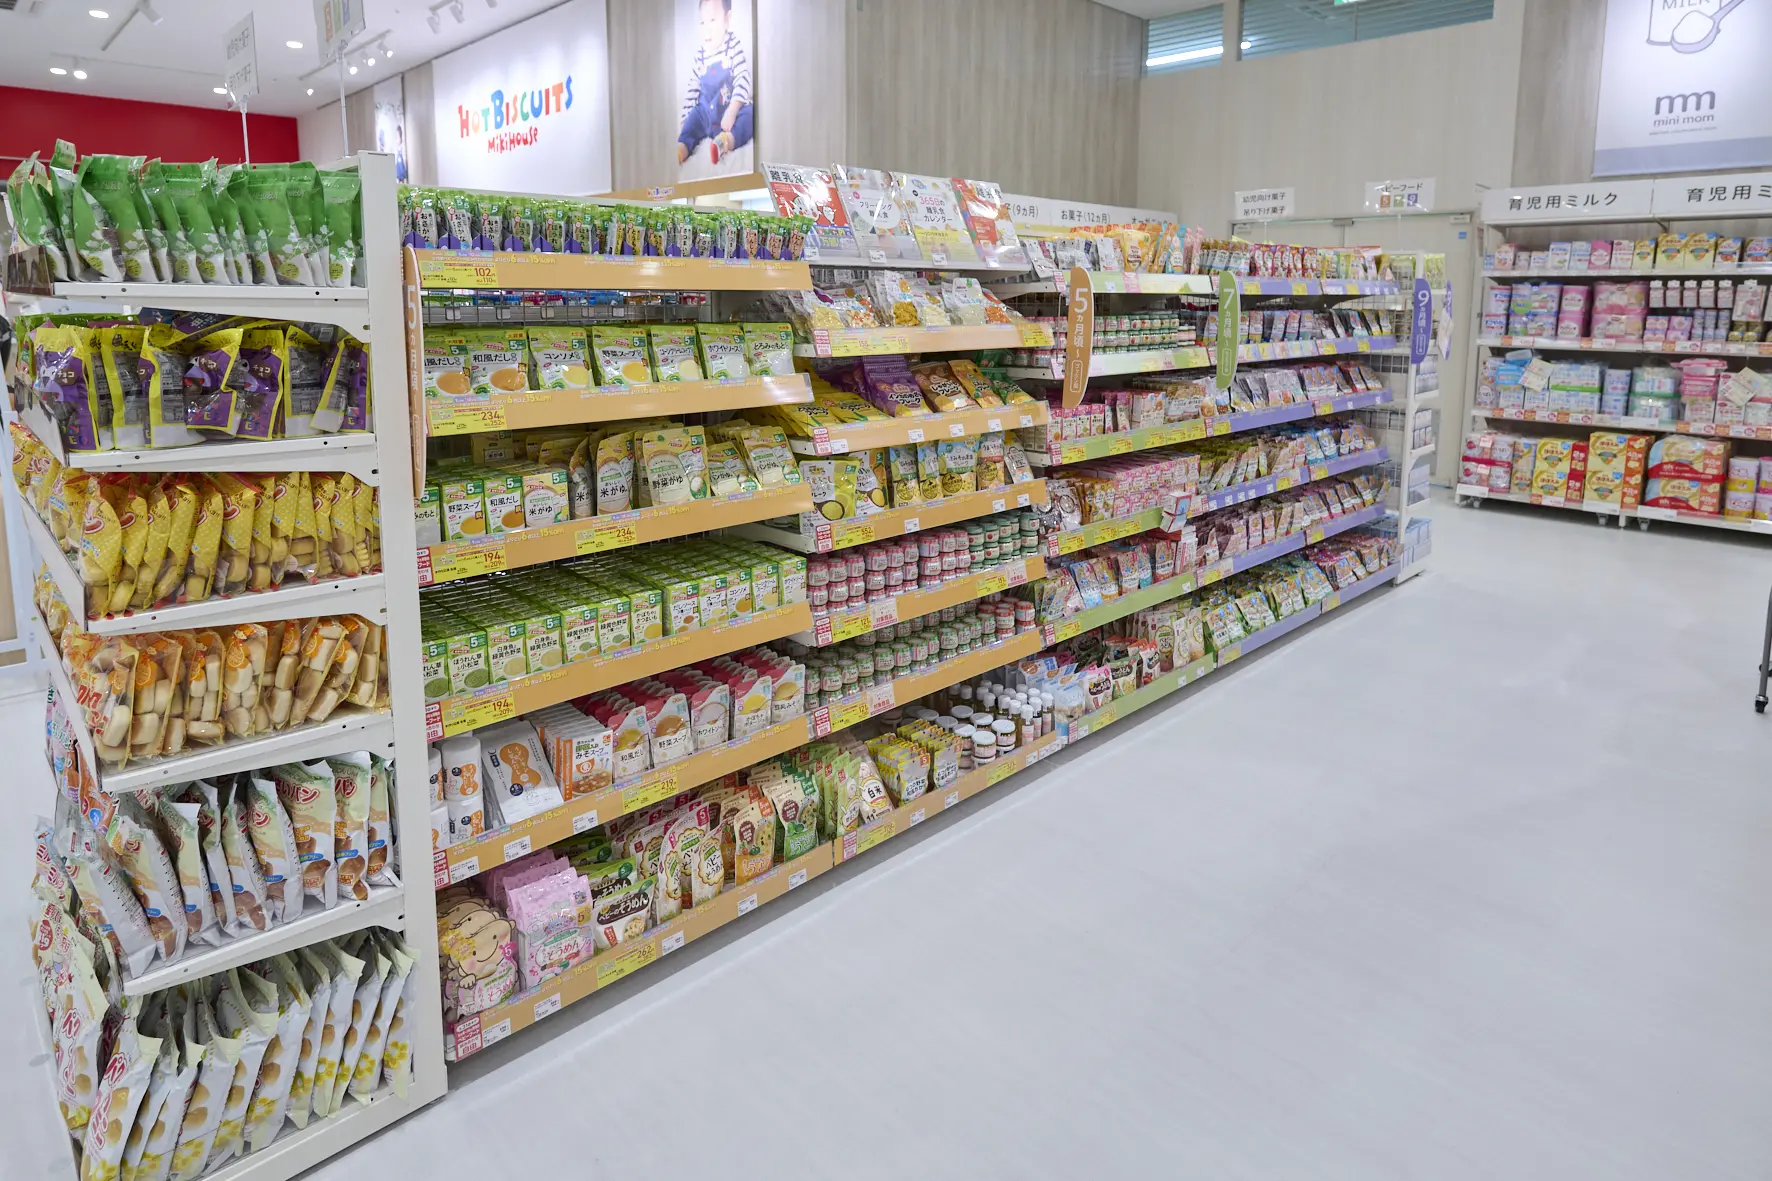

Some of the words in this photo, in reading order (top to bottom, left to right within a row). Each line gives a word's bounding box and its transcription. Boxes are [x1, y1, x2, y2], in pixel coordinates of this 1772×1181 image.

[458, 104, 490, 138] HOT
[491, 75, 573, 130] BISCUITS
[1653, 116, 1680, 127] mini
[1682, 114, 1714, 124] mom
[1242, 192, 1287, 204] 幼児向け菓子
[1508, 192, 1618, 211] 育児用ミルク
[924, 215, 953, 223] カレンダー
[424, 356, 461, 366] 風だし8
[652, 476, 683, 490] 野菜がゆ
[600, 486, 628, 498] 米がゆ
[448, 501, 480, 513] 野菜スープ
[490, 496, 518, 506] 和風だし
[529, 506, 553, 516] 米がゆ
[730, 587, 746, 596] コンソメ
[706, 594, 721, 602] スープ
[453, 653, 482, 664] ほうれん草
[658, 736, 687, 748] 野菜スープ
[576, 748, 604, 759] みそスープ
[620, 751, 643, 761] 和風だし
[868, 785, 882, 799] 白米
[599, 894, 648, 921] ベビーのそうめん
[548, 942, 580, 960] そうめん
